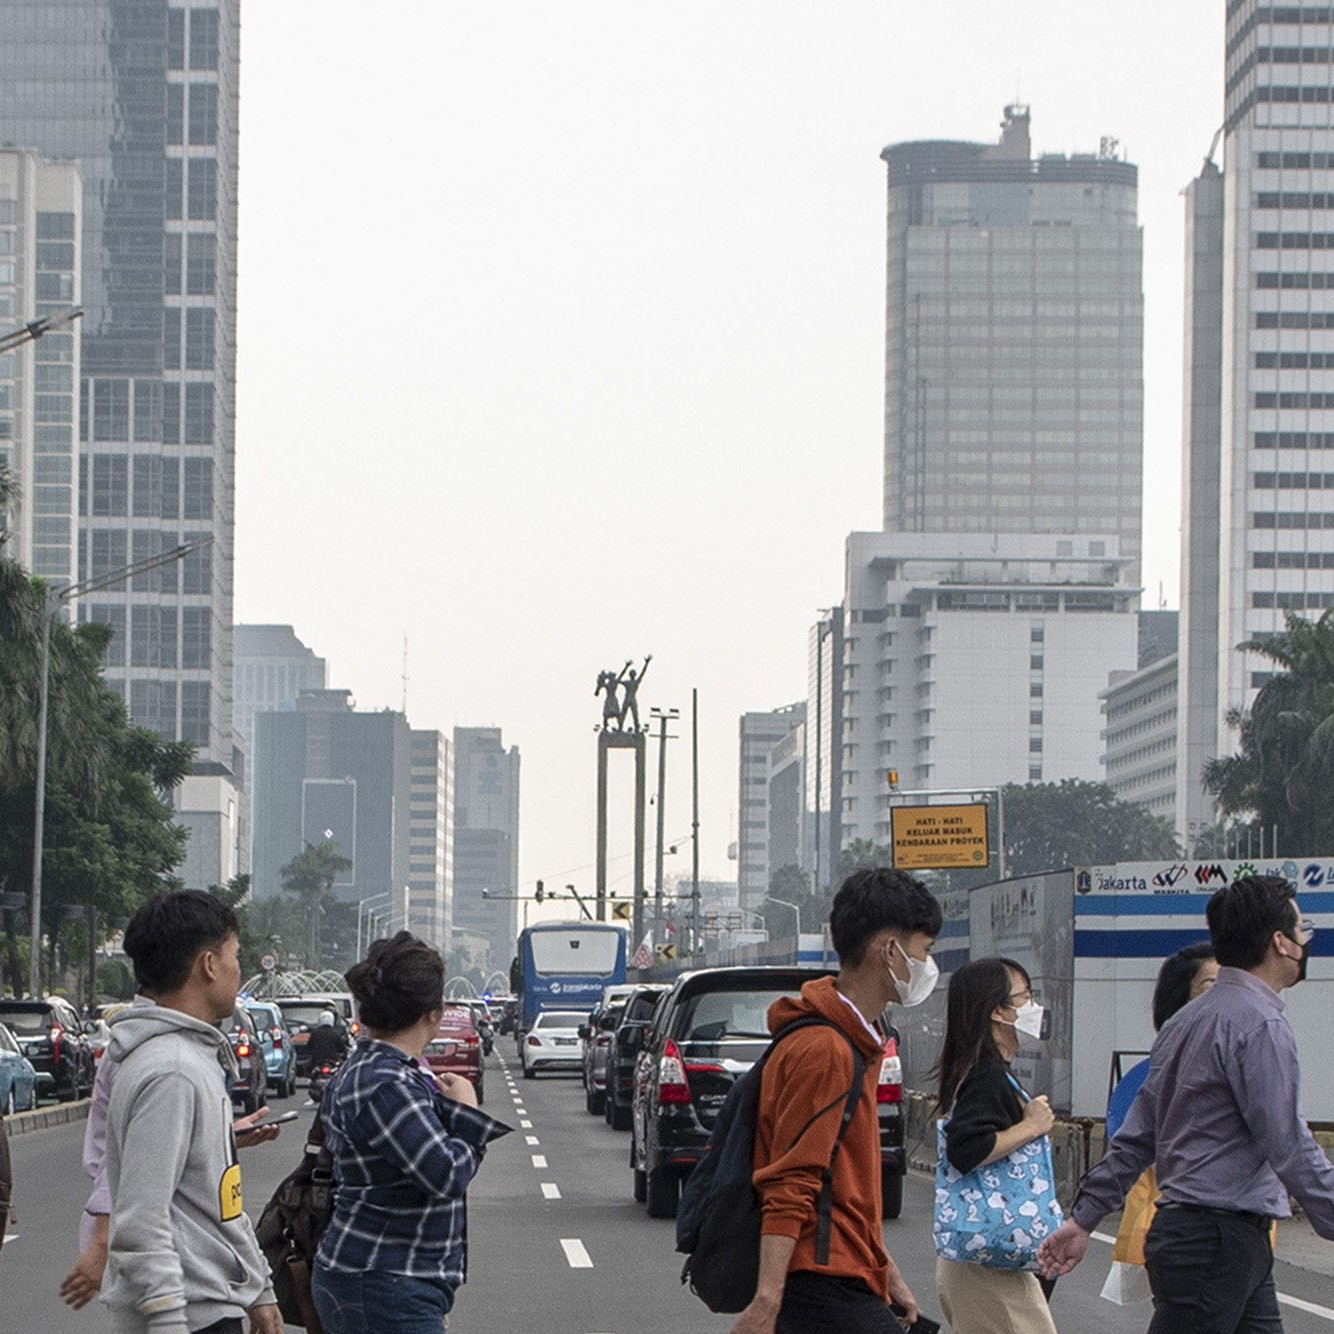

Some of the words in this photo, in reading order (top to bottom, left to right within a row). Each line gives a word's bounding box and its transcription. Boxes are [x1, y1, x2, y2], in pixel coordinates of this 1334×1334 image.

[915, 818, 936, 826] HATI
[943, 817, 963, 825] HATI
[906, 828, 940, 836] KELUAR
[942, 827, 973, 835] MASUK
[896, 838, 948, 847] KENDARAAN
[950, 837, 984, 846] PROYEK
[1098, 875, 1147, 891] Jakarta
